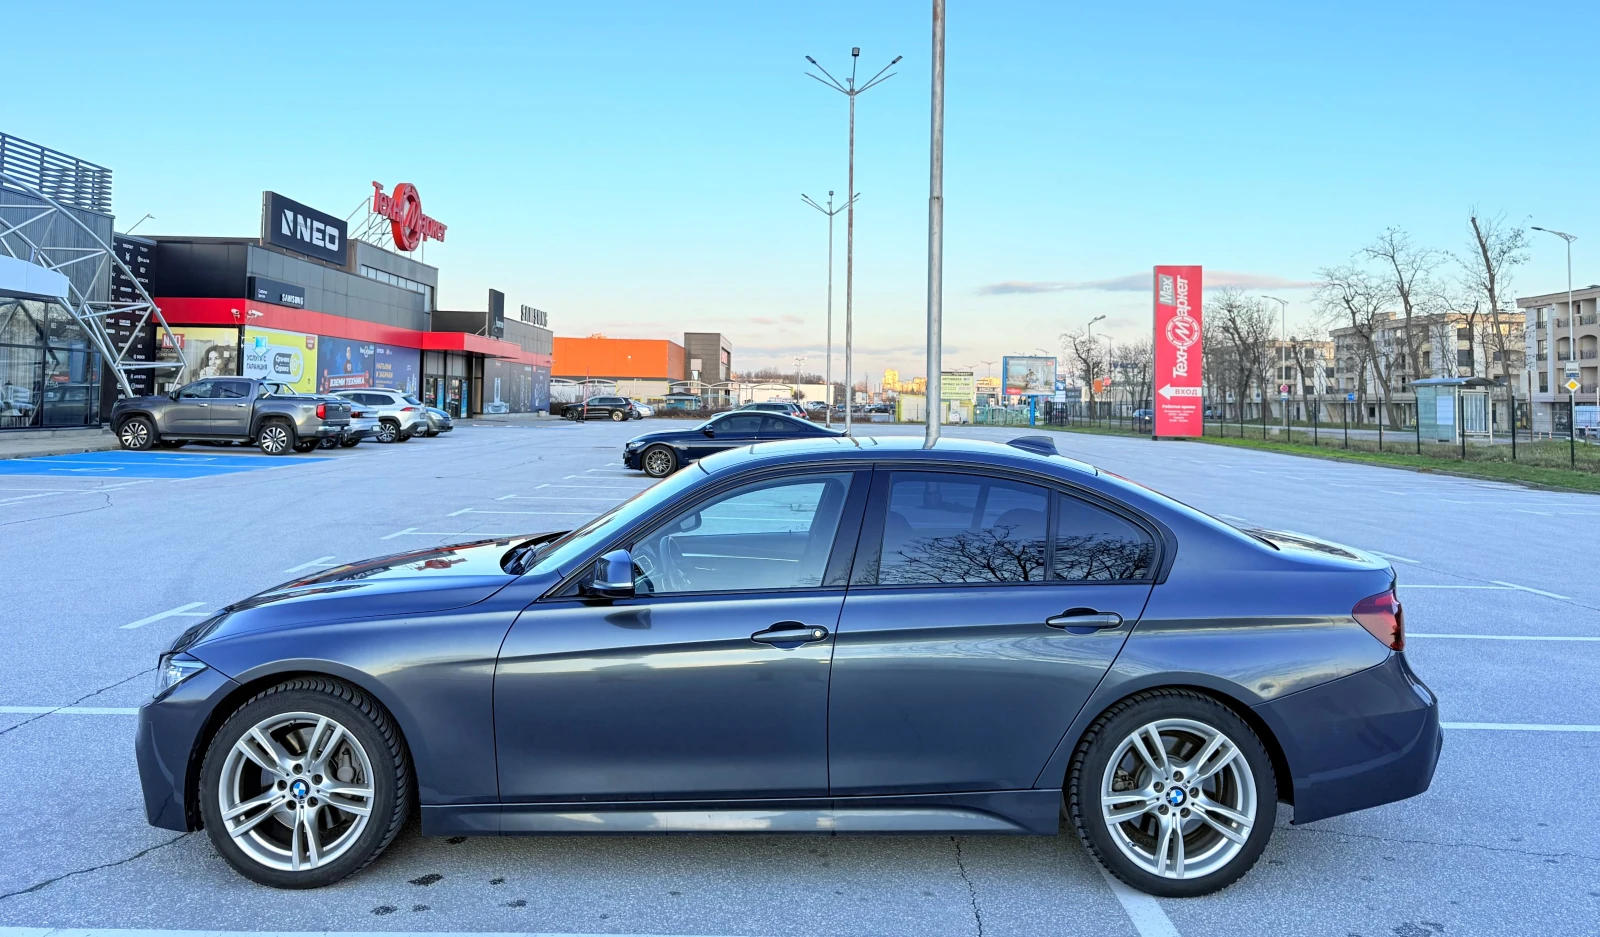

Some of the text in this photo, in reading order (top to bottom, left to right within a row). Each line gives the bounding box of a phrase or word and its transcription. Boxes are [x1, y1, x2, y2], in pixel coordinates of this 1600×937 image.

[296, 213, 340, 252] NEO
[281, 293, 304, 306] SAMSUNG
[1159, 277, 1173, 304] Max
[520, 304, 548, 328] SAMSUNG
[1174, 388, 1198, 396] ВХОД
